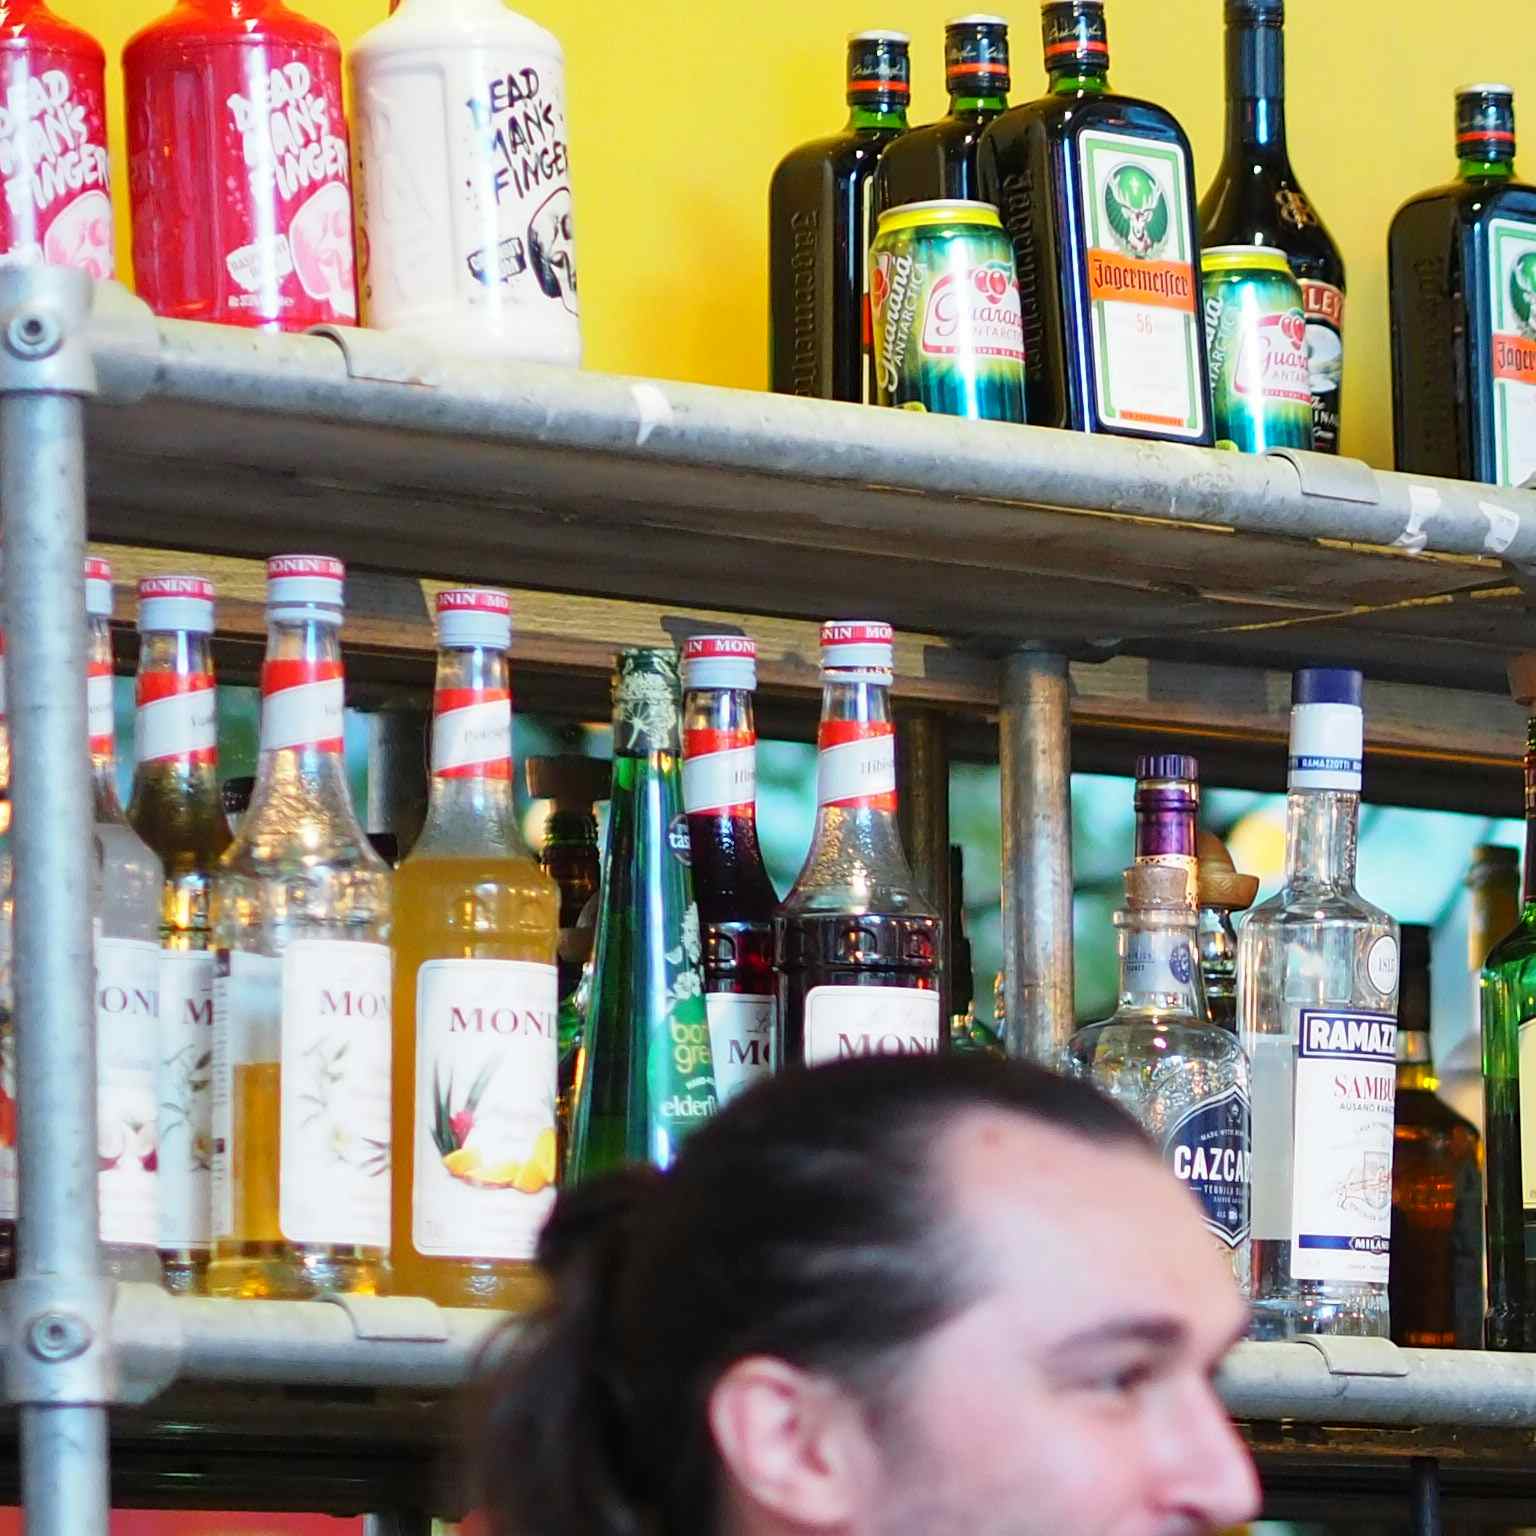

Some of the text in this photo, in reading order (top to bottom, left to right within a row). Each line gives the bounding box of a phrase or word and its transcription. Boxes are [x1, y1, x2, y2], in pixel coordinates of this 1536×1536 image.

[492, 140, 569, 206] FINGE
[270, 559, 321, 574] ONIN
[141, 579, 193, 593] ONIN
[669, 832, 691, 849] tas
[449, 1006, 557, 1037] MONI
[673, 1043, 711, 1075] gre
